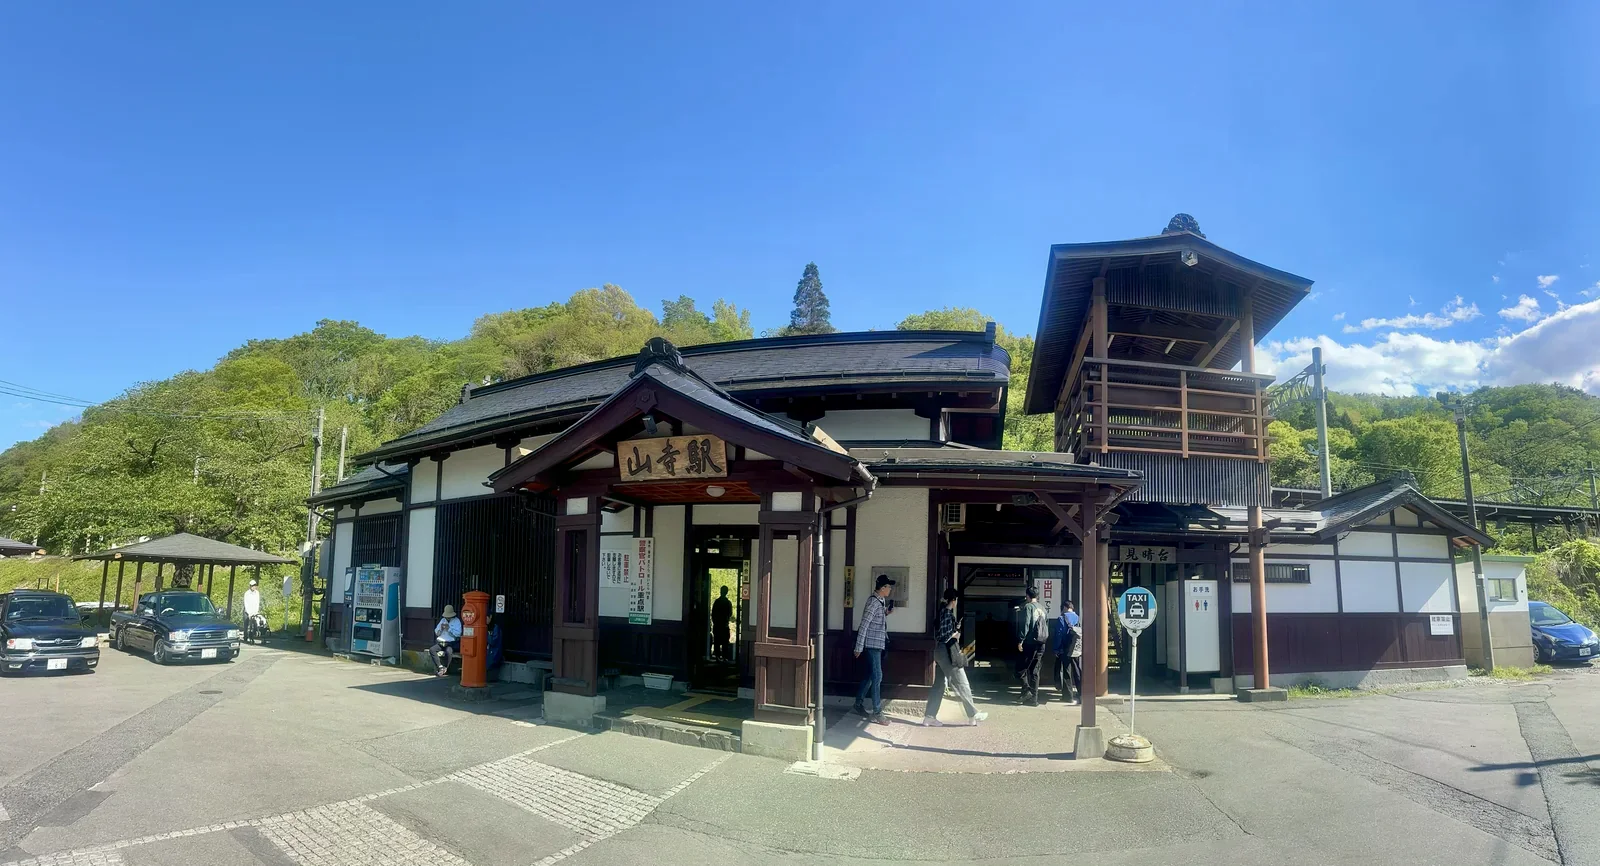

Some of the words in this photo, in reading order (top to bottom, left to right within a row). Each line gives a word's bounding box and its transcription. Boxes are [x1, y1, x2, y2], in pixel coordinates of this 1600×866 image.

[627, 438, 723, 477] 山寺駅
[1126, 547, 1169, 561] 見晴台
[637, 540, 646, 612] 警察官パトロール重点駅
